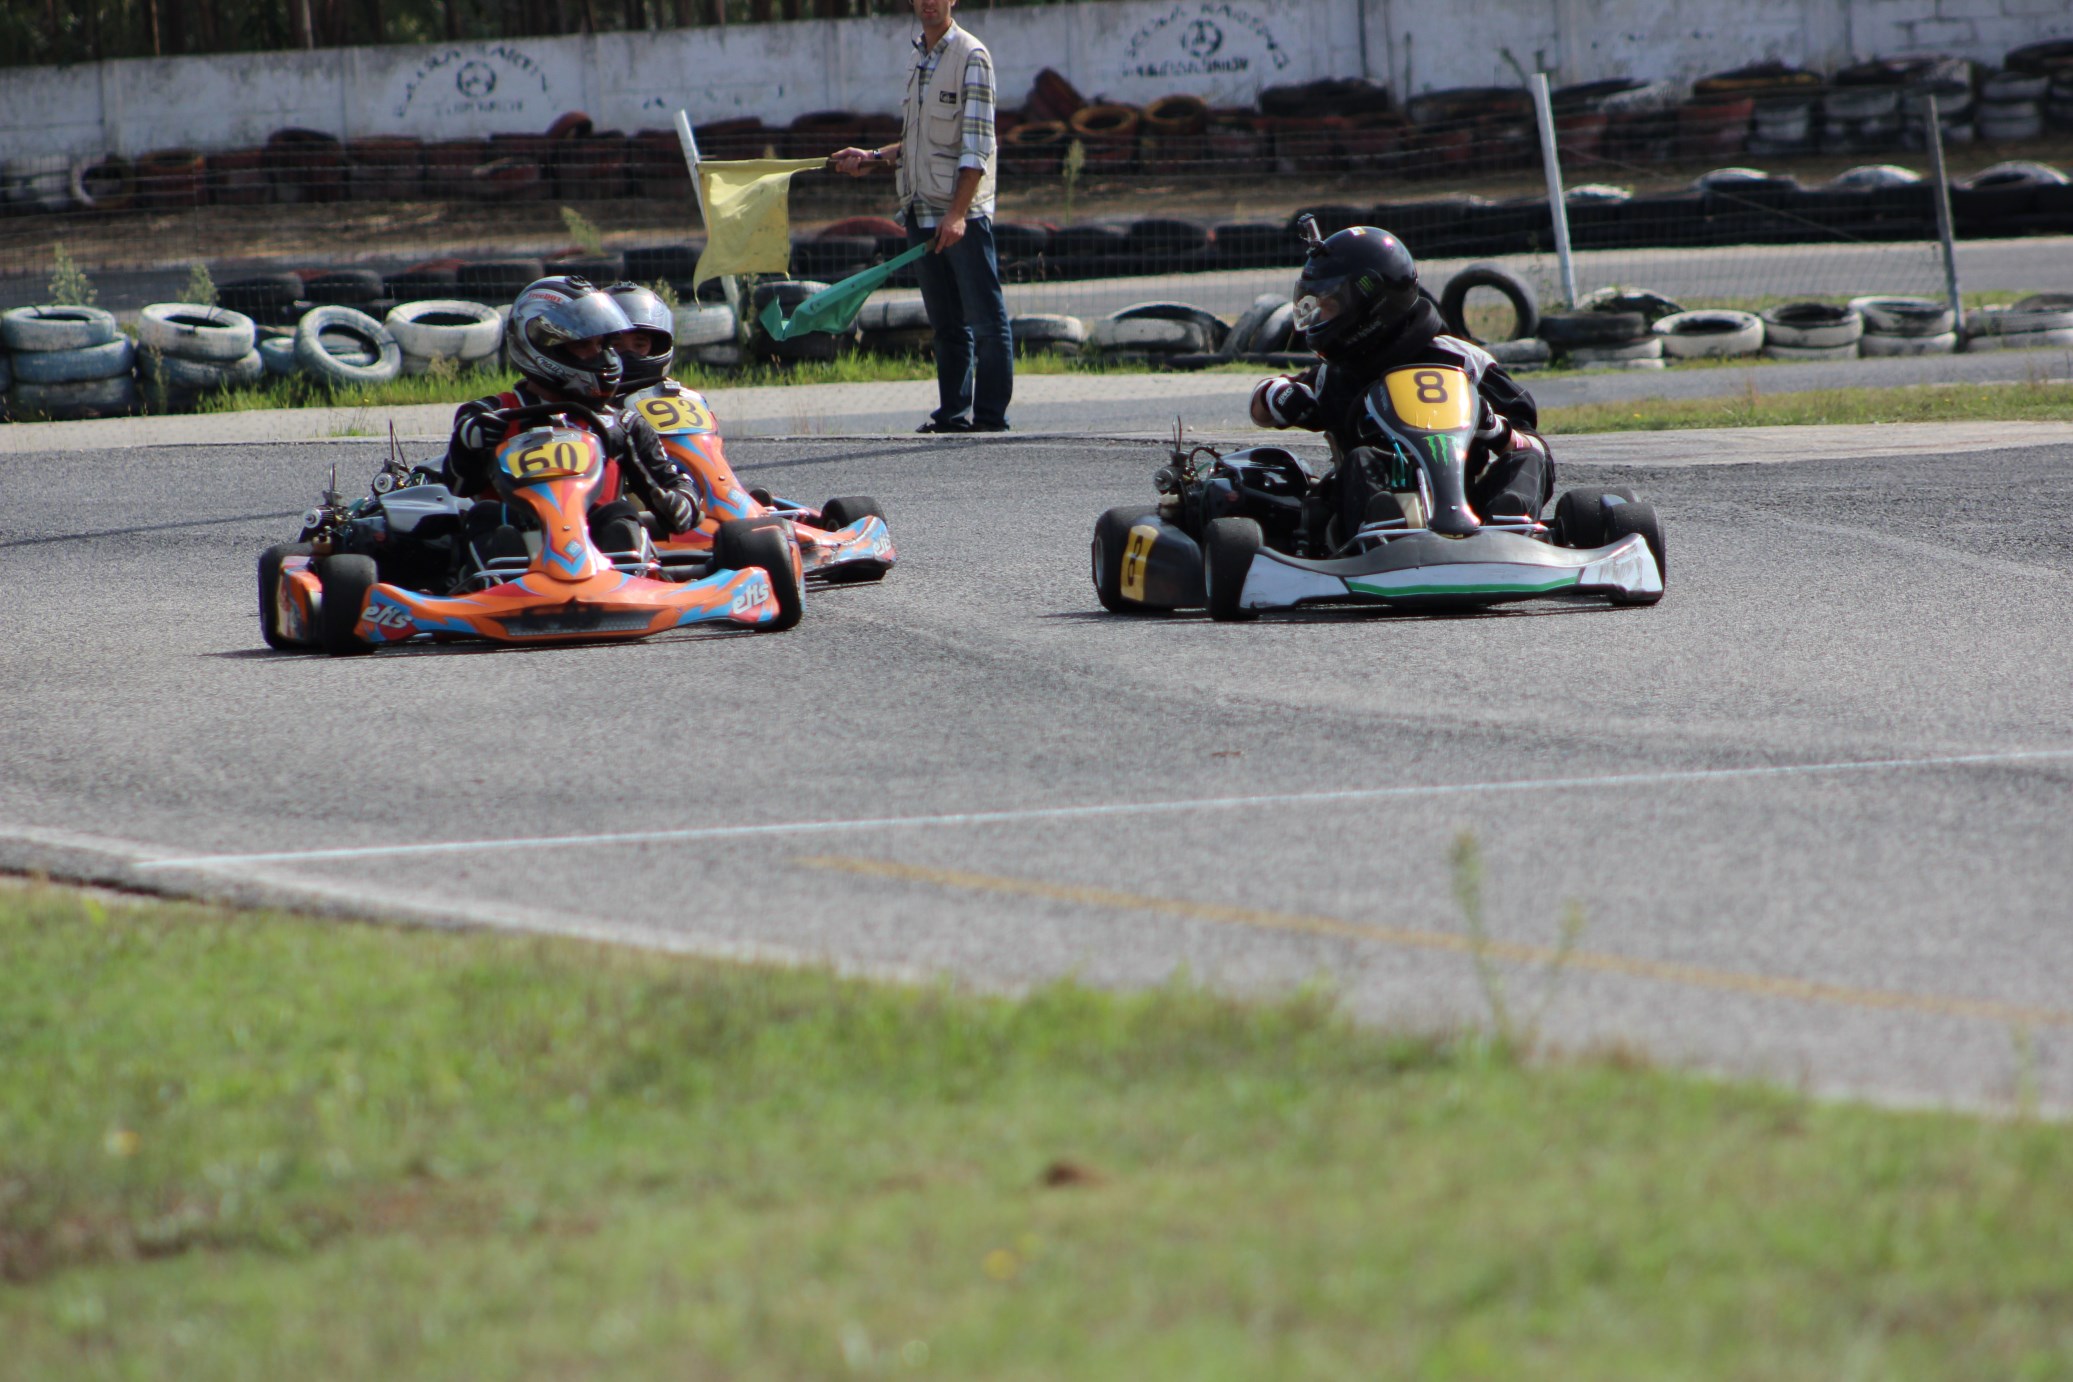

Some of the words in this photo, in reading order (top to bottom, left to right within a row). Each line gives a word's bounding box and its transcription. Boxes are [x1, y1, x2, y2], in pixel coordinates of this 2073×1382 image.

[1413, 370, 1449, 404] 8
[645, 399, 705, 428] 93
[518, 442, 579, 474] 60
